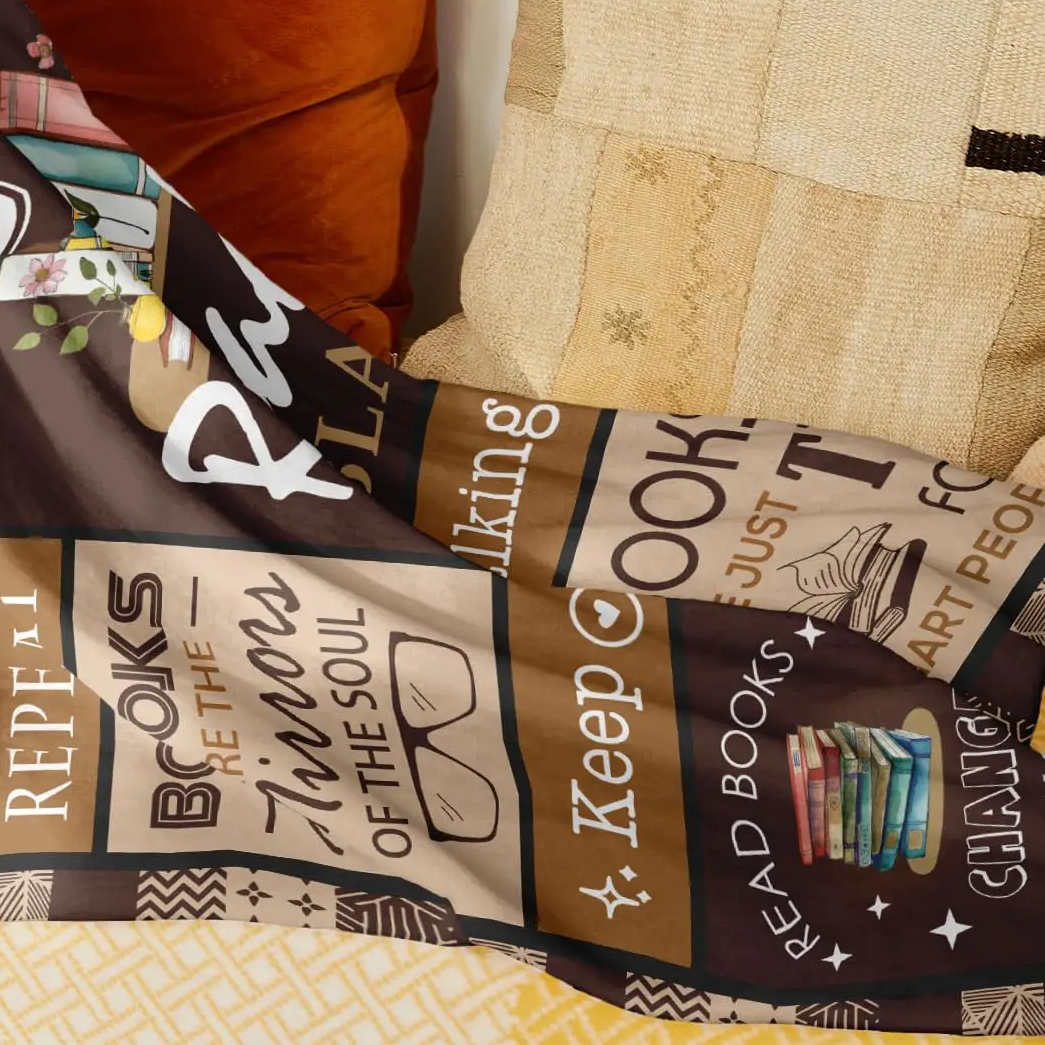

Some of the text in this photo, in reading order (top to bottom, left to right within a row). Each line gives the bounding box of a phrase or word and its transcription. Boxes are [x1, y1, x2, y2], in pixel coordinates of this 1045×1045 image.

[450, 397, 560, 578] lking
[611, 413, 758, 591] OOK
[725, 490, 798, 589] JUST
[182, 640, 246, 784] RE THE
[906, 585, 974, 678] ART
[316, 608, 412, 858] OF THE SOUL
[571, 664, 643, 848] Keep
[721, 639, 794, 800] BOOKS
[952, 688, 1027, 898] CHANG
[730, 819, 820, 960] READ
